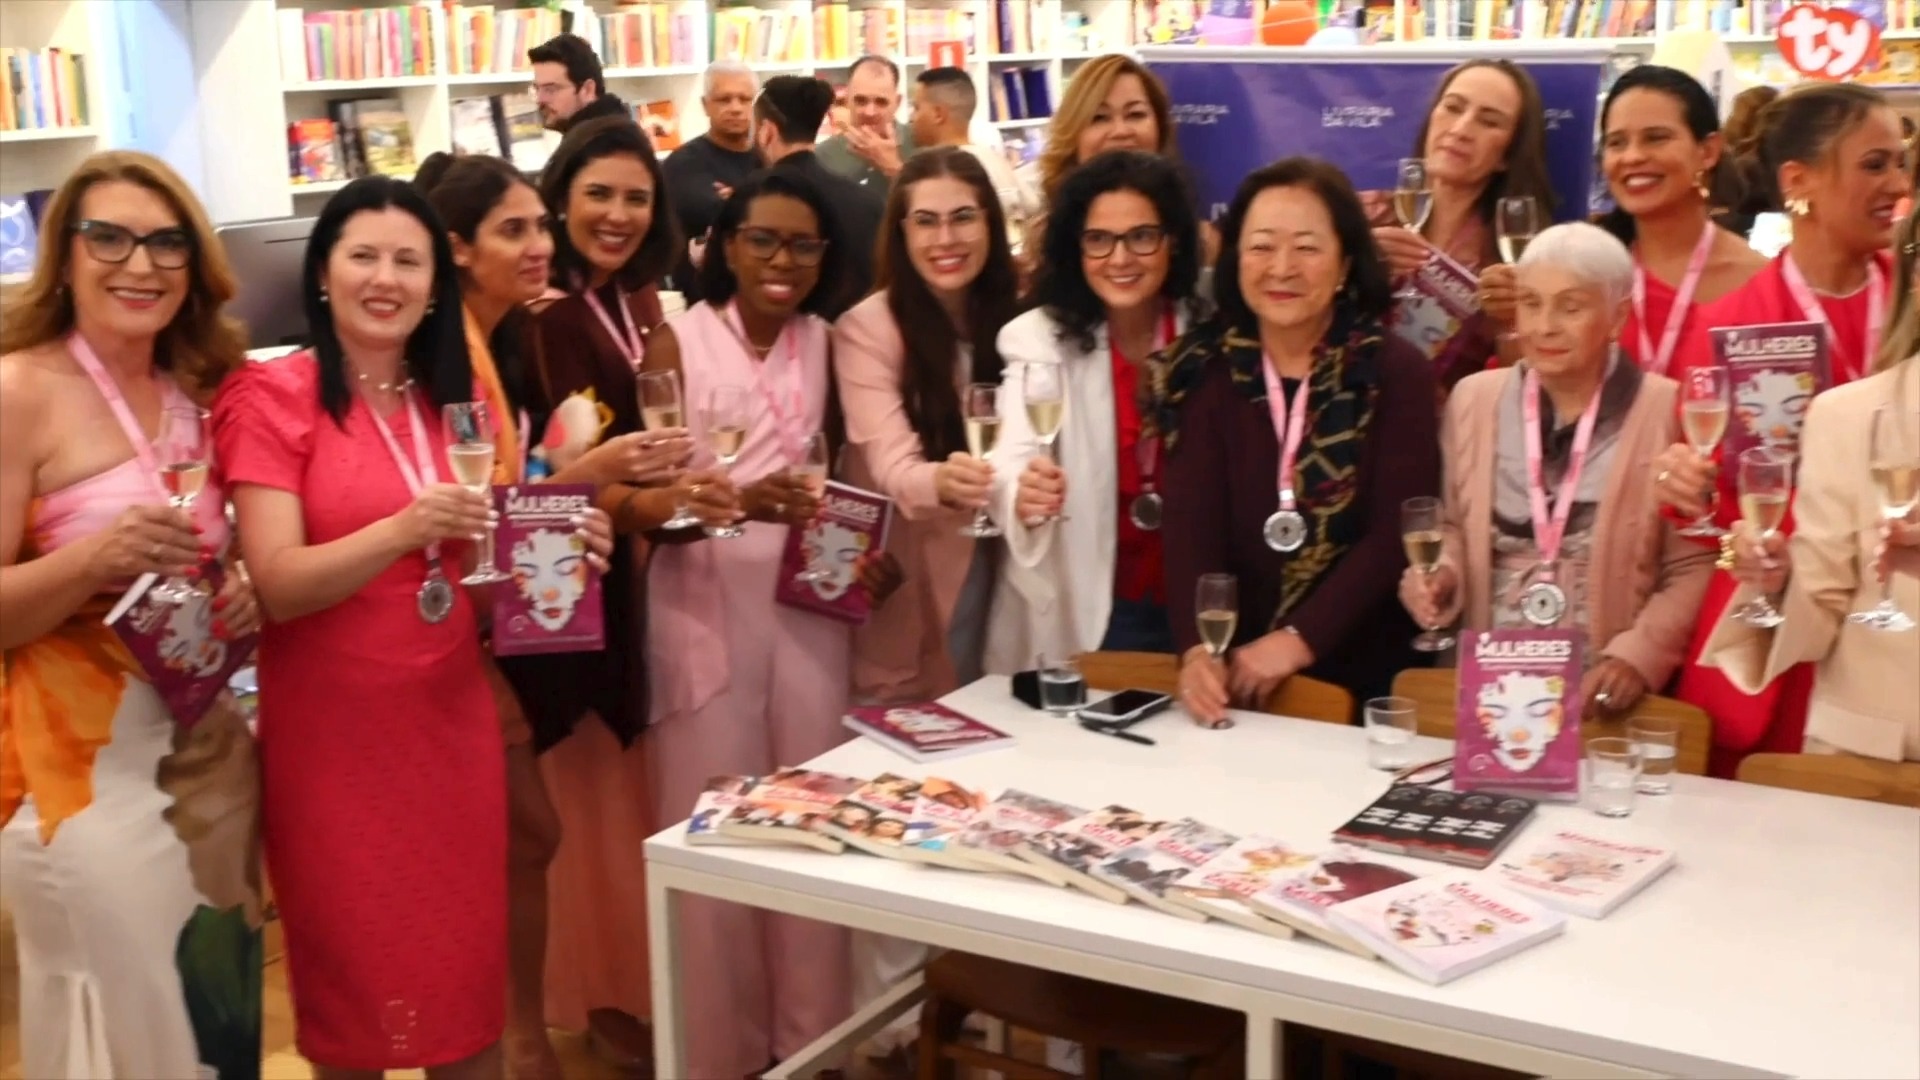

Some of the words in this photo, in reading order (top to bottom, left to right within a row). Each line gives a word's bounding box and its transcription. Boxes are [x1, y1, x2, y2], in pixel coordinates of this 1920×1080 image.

[1780, 7, 1871, 77] ty
[1724, 334, 1817, 357] MULHERES
[1474, 639, 1572, 658] MULHERES
